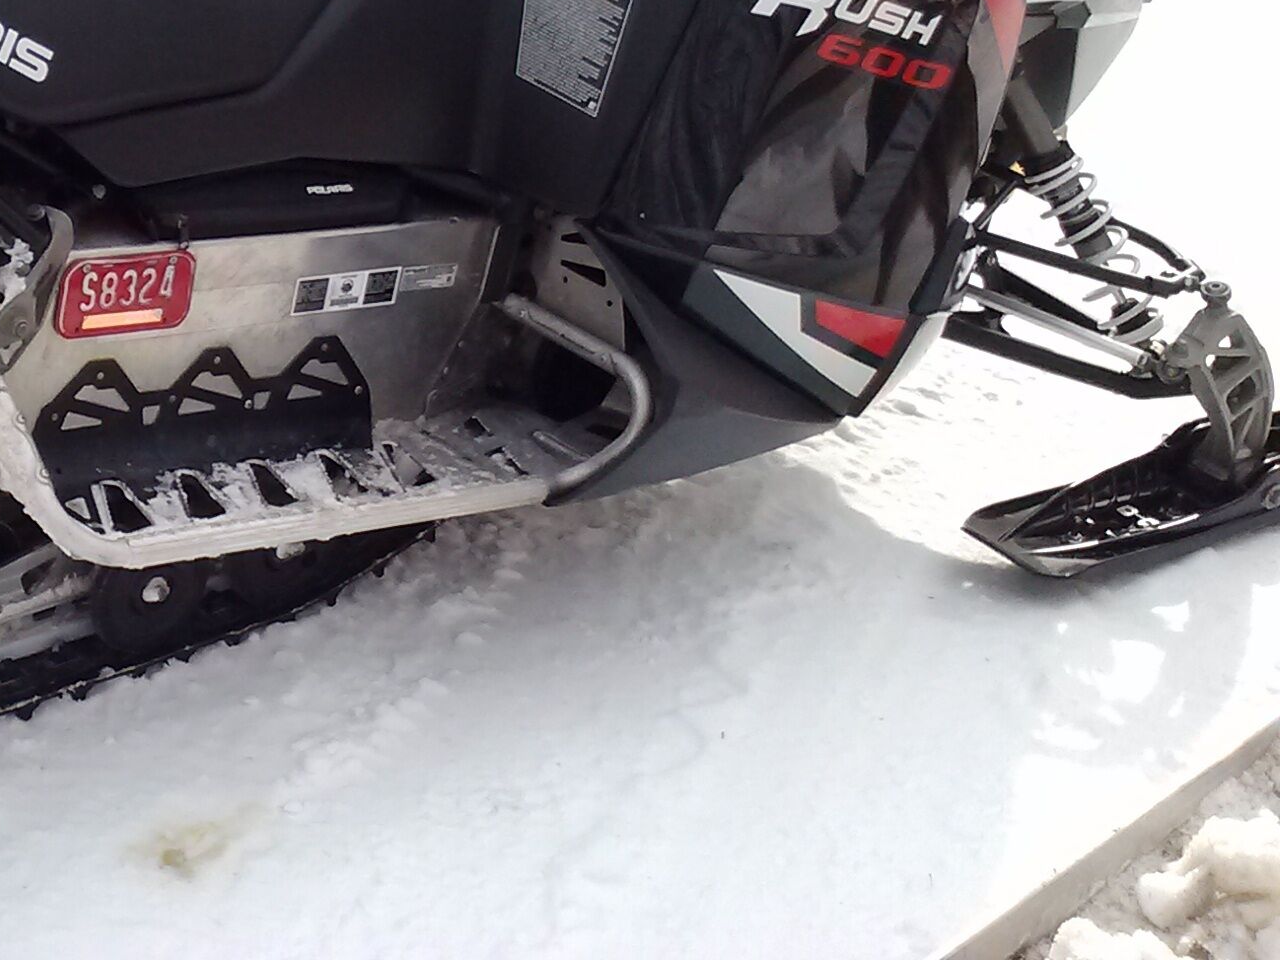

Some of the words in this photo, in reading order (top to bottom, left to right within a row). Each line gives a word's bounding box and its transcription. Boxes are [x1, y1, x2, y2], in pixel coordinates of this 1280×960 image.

[817, 33, 952, 90] 600
[306, 184, 353, 194] POLARIS
[79, 265, 176, 312] S8324
